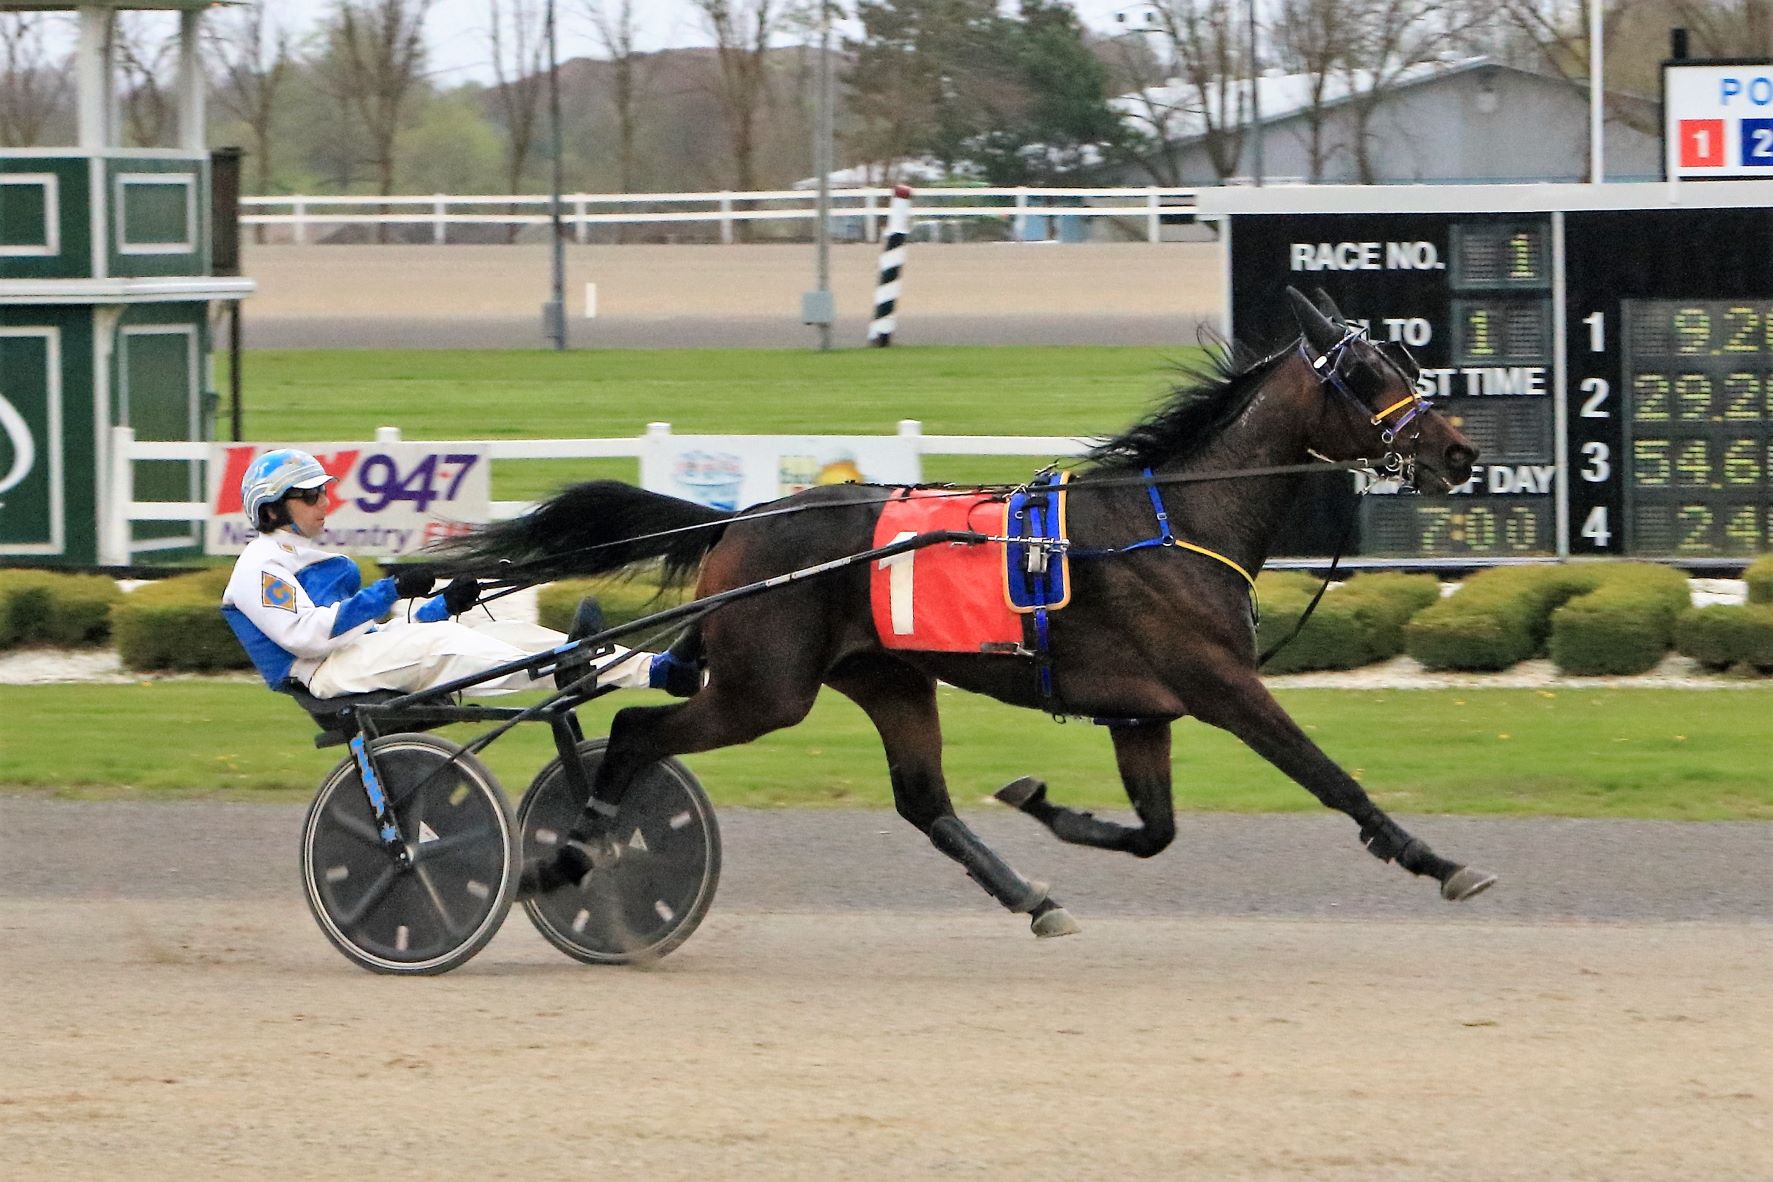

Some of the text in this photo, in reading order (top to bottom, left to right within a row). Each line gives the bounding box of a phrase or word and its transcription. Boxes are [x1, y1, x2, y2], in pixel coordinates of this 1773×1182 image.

[1691, 128, 1773, 159] 1 2
[1289, 241, 1446, 271] RACE NO.
[1510, 233, 1535, 278] 1
[1382, 317, 1432, 347] TO
[1470, 310, 1494, 355] 1
[1582, 311, 1605, 352] 1
[1460, 367, 1546, 396] TIME
[1580, 377, 1610, 418] 2
[1633, 373, 1773, 422] 29.2
[1488, 464, 1558, 494] DAY
[1580, 441, 1611, 483] 3
[1634, 439, 1773, 490] 54.6
[1581, 506, 1612, 547] 4
[878, 531, 918, 636] 1
